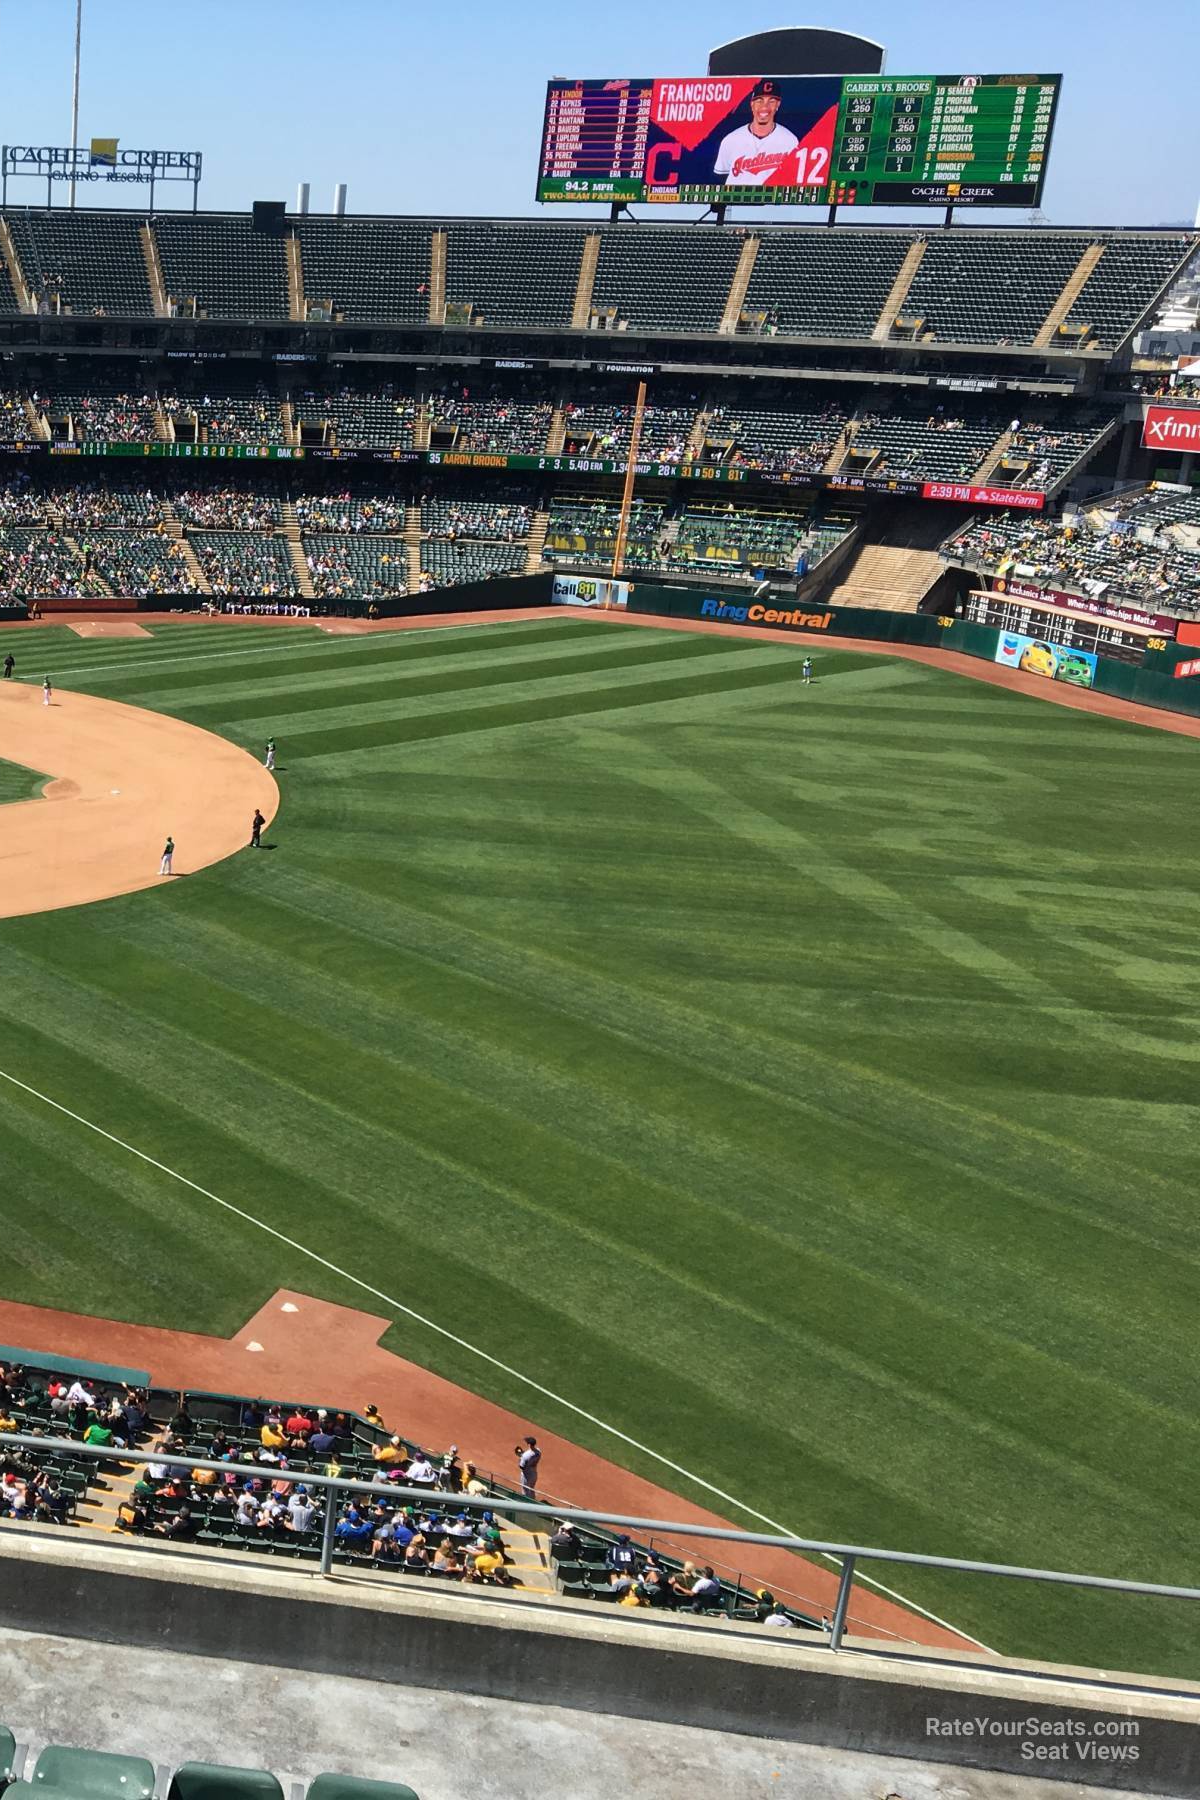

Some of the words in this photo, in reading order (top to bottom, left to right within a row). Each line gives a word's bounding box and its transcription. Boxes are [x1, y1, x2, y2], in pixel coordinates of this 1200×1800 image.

[660, 84, 732, 102] FRANCISCO
[846, 84, 879, 92] CAREER
[882, 84, 895, 92] VS.
[896, 84, 930, 92] BROOKS
[657, 104, 704, 121] LINDOR
[558, 117, 585, 125] SANTANA
[940, 134, 974, 142] PISCOTTY
[10, 146, 84, 162] CACHE
[121, 150, 191, 166] CREEK
[796, 147, 828, 184] 12
[52, 171, 99, 182] CASINO
[106, 172, 151, 183] RESORT
[1000, 174, 1013, 182] ERA
[565, 182, 589, 190] 94.2
[606, 364, 654, 373] FOUNDATION
[1149, 416, 1200, 441] xfini
[246, 448, 258, 456] CLE
[278, 448, 292, 458] OAK
[430, 454, 440, 464] 35
[443, 454, 470, 465] AARON
[473, 455, 507, 466] BROOKS
[569, 460, 588, 470] 5.40
[590, 462, 603, 470] ERA
[658, 465, 670, 476] 28
[681, 466, 692, 477] 31
[702, 468, 714, 478] 50
[832, 476, 848, 485] 94.2
[931, 486, 952, 498] 2:39
[954, 488, 970, 500] PM
[554, 582, 576, 596] Call
[577, 582, 596, 595] 811
[702, 600, 830, 628] RingCentral
[1040, 591, 1057, 602] Bank
[1067, 598, 1088, 609] Where
[1133, 614, 1157, 626] Matter
[937, 616, 954, 628] 367
[1146, 638, 1167, 651] 362
[620, 1552, 632, 1562] 12
